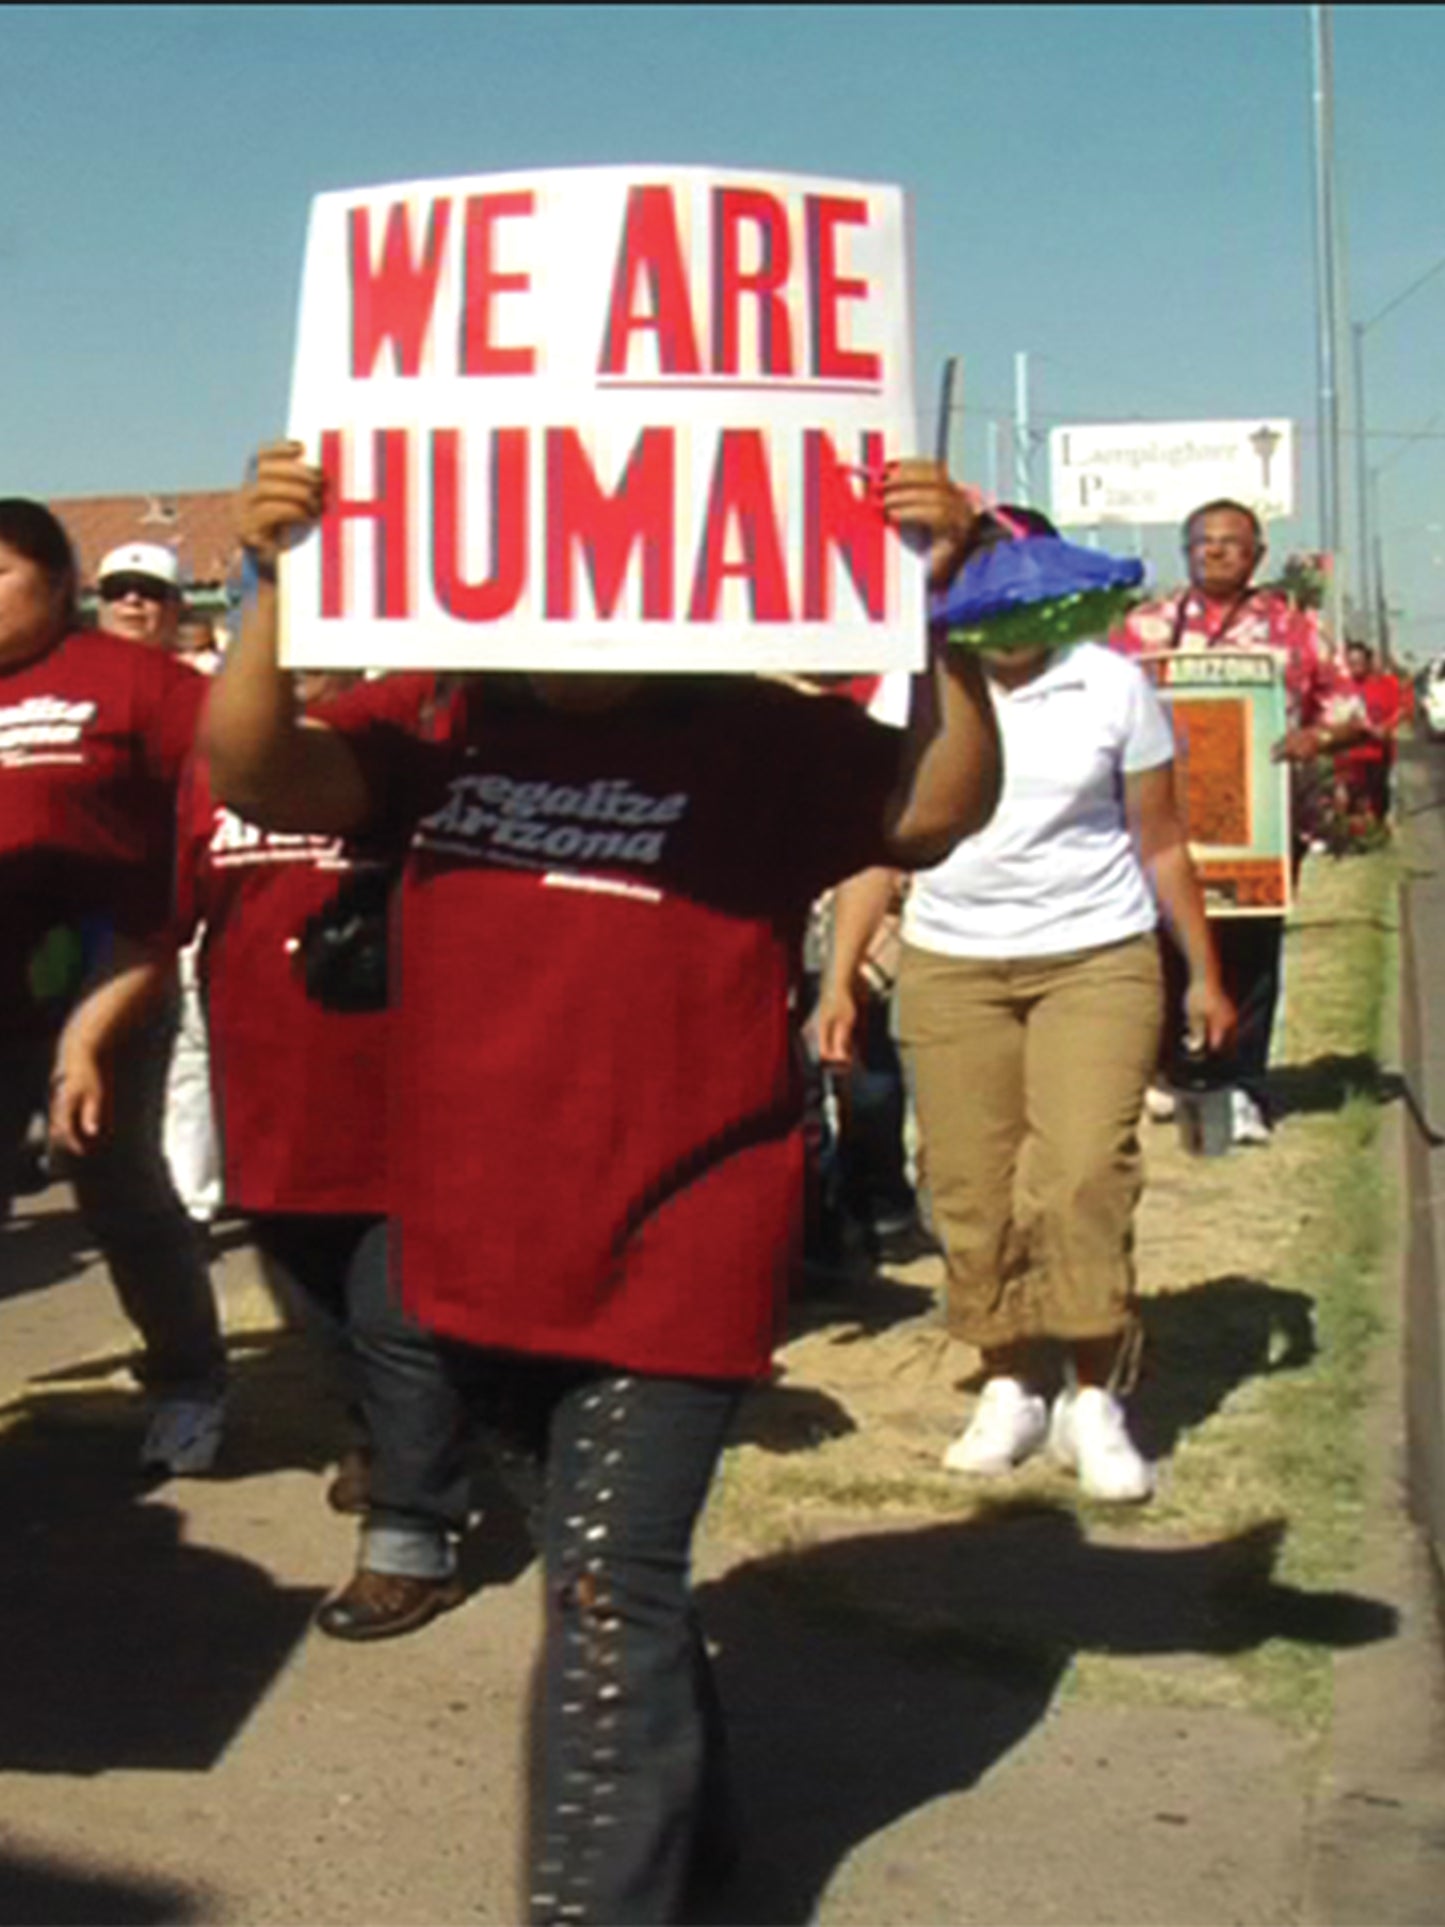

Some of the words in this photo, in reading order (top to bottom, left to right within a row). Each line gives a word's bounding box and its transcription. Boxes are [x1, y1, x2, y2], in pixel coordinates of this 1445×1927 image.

[346, 188, 536, 379] WE
[595, 184, 883, 382] ARE
[318, 425, 886, 624] HUMAN
